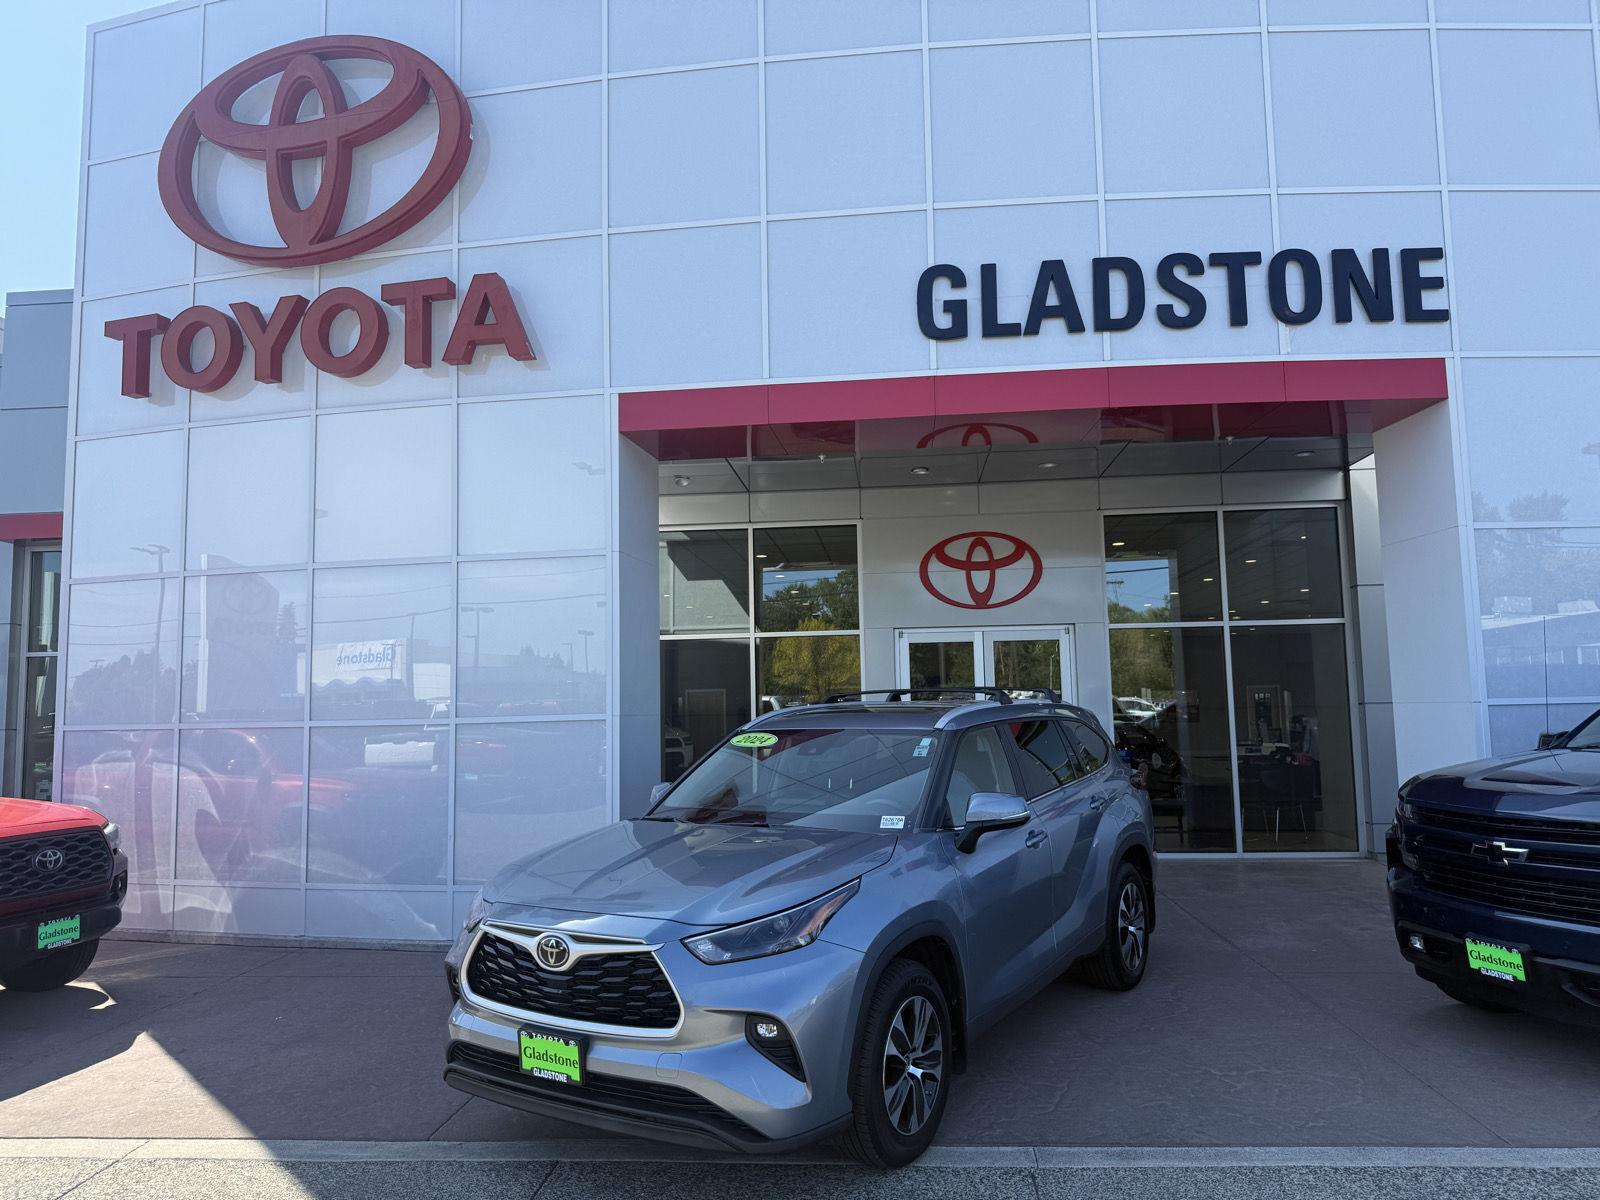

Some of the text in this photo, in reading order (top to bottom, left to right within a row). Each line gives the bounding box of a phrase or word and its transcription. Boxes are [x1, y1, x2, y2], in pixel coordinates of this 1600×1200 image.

[917, 247, 1450, 341] GLADSTONE
[104, 272, 536, 399] TOYOTA
[736, 735, 772, 744] 2024
[39, 925, 79, 941] Gladstone
[47, 939, 72, 949] GLADSTONE
[1469, 950, 1523, 971] Gladstone
[1481, 968, 1514, 981] GLADSTONE
[532, 1033, 565, 1044] TOYOTA
[523, 1046, 579, 1068] Gladstone
[533, 1068, 567, 1082] GLADSTONE
